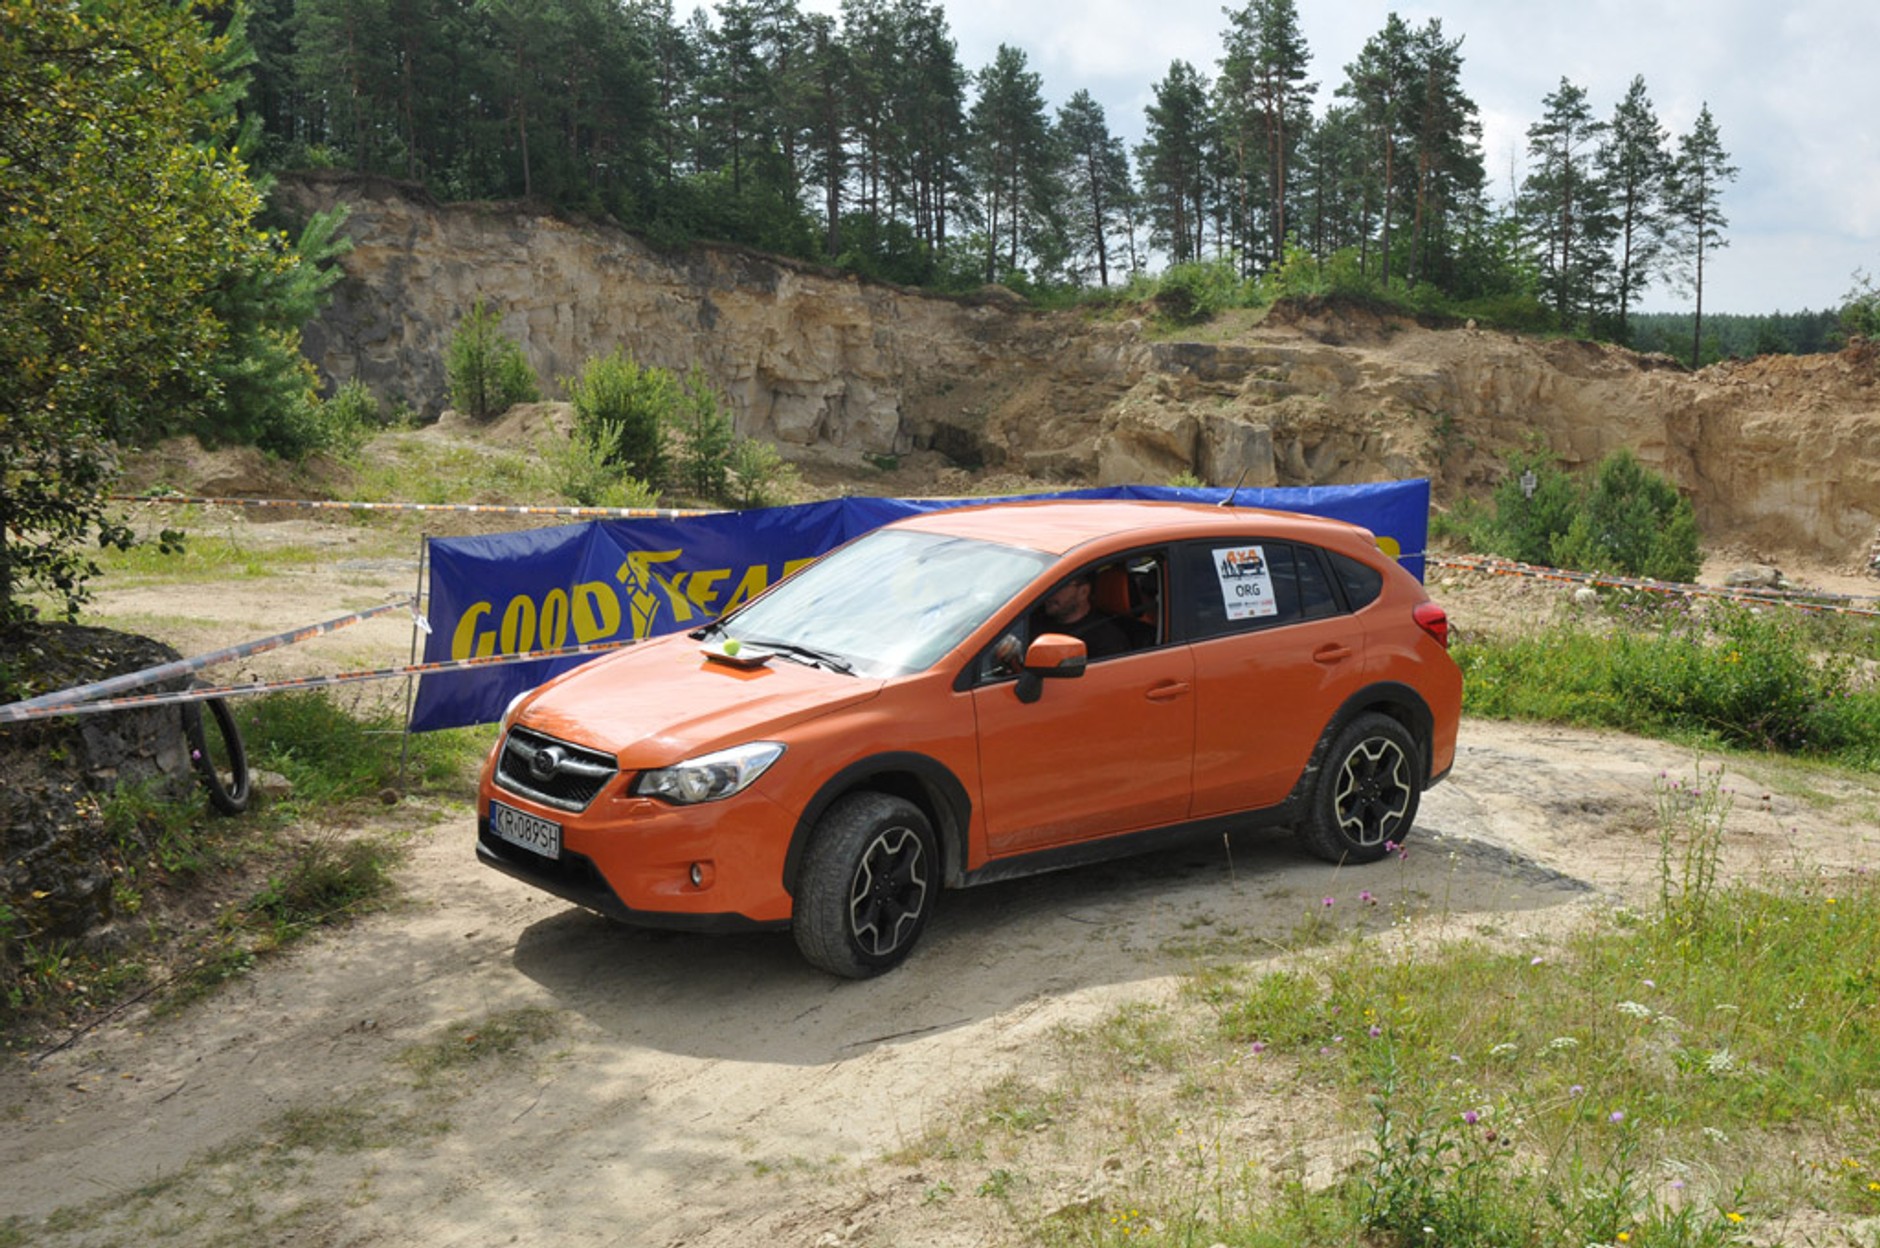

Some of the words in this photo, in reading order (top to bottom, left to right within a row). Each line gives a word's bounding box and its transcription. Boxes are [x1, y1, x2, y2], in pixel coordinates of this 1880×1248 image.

[452, 581, 621, 658] GOOD
[654, 557, 819, 622] YEA
[1235, 583, 1261, 597] ORG
